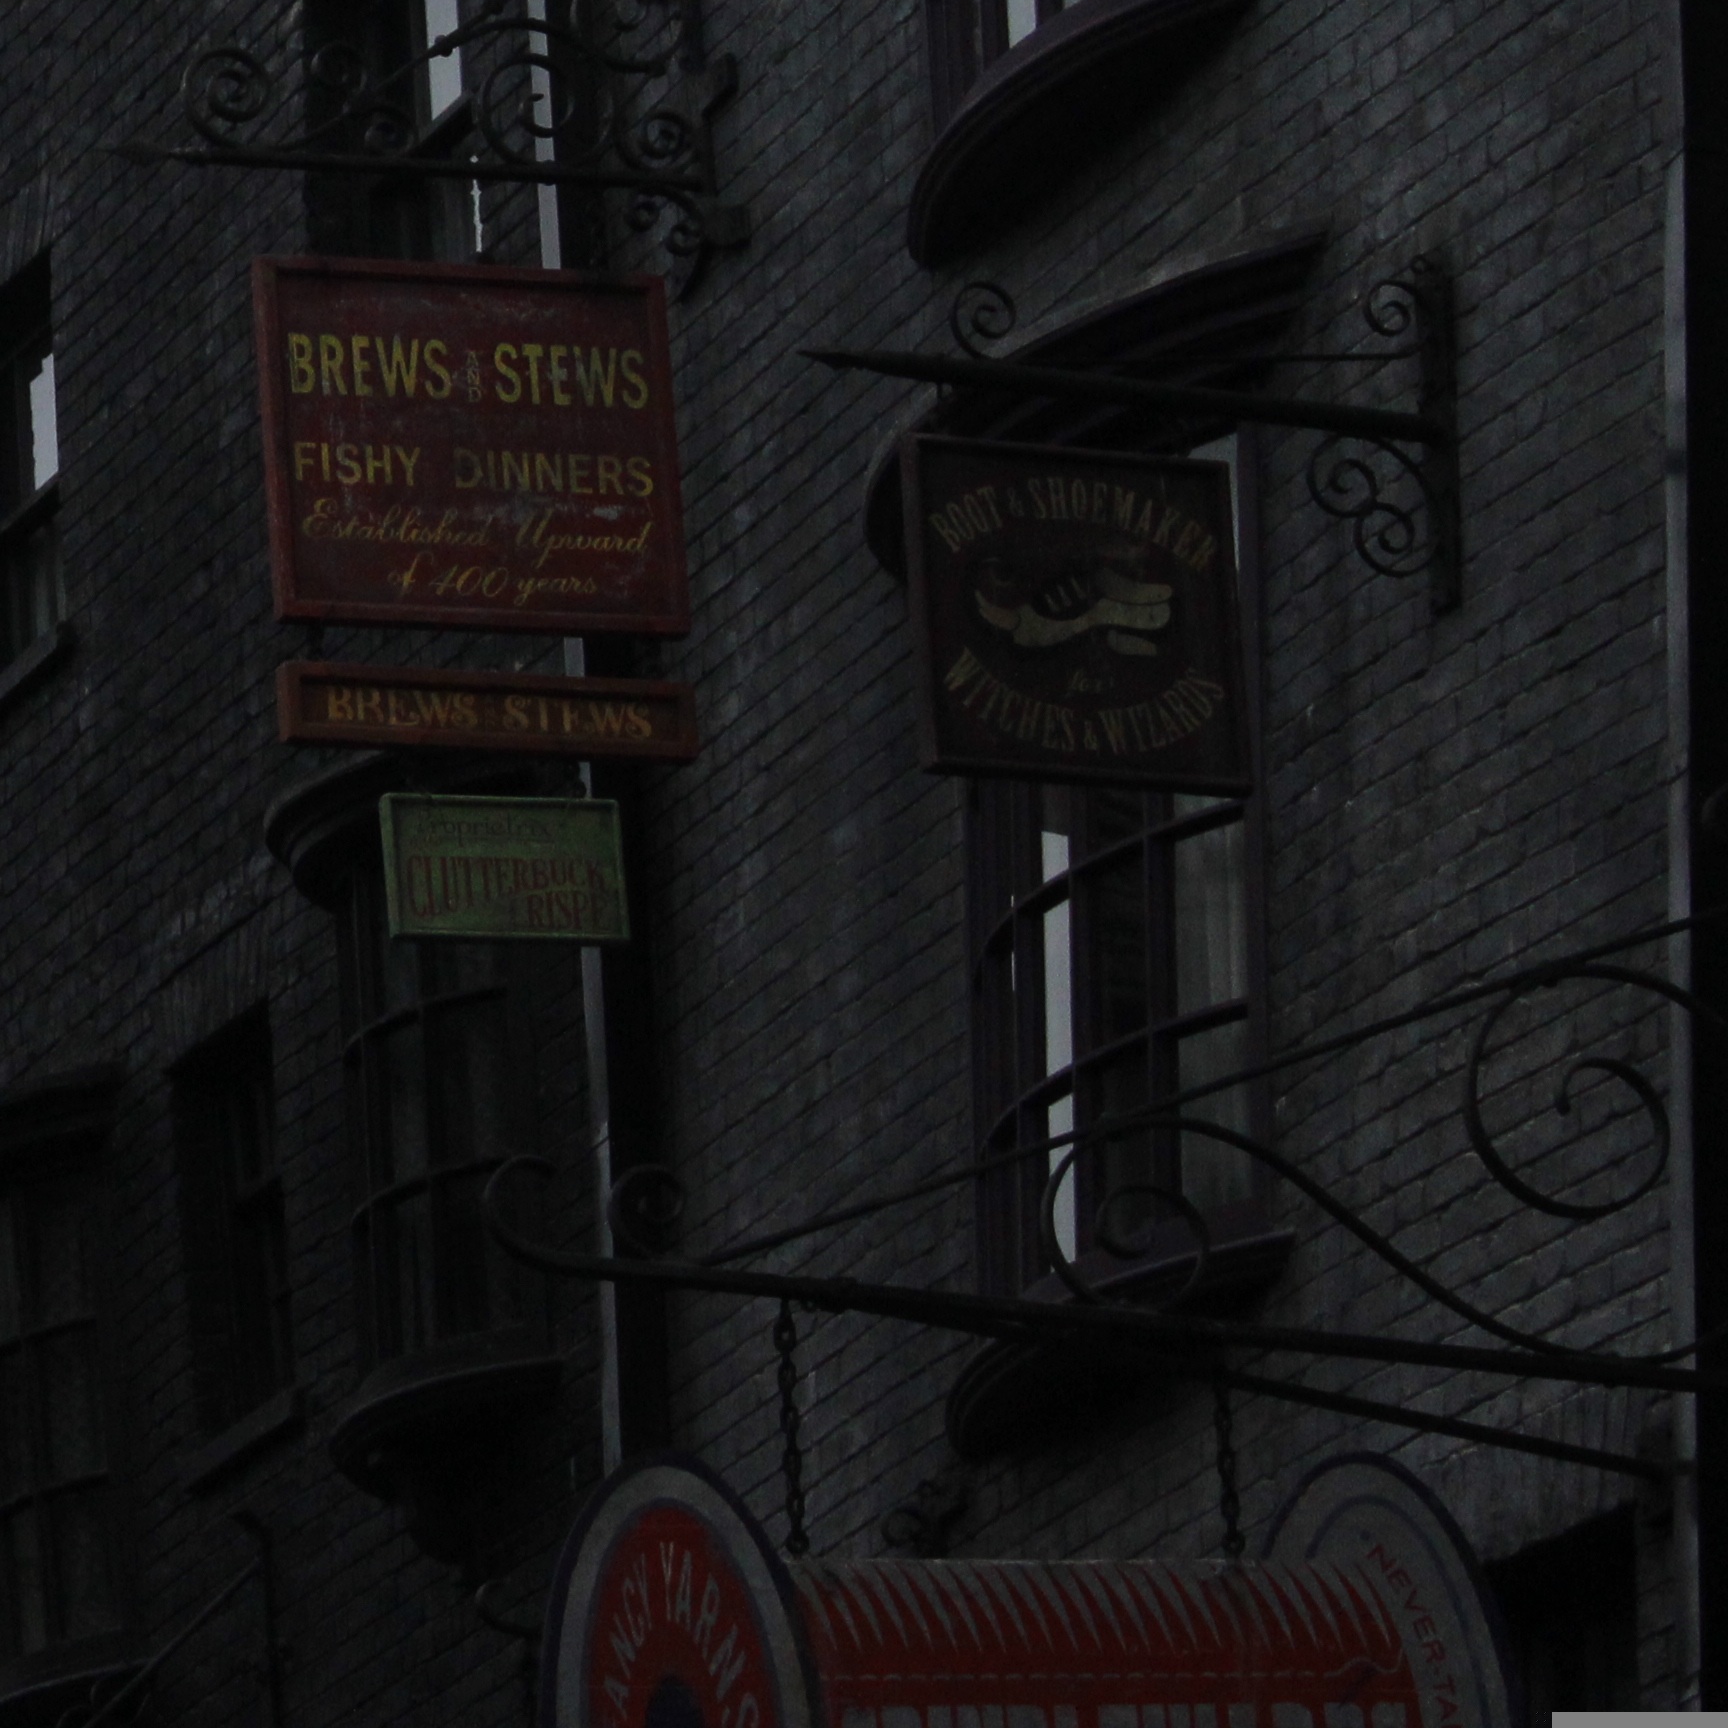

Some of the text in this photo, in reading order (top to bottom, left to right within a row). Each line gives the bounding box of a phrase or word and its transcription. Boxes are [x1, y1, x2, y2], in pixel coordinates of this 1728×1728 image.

[288, 332, 649, 410] BREWS AND STEWS
[293, 441, 654, 498] FISHY DINNERS
[302, 497, 653, 567] Established Upward
[929, 476, 1217, 571] BOOT & SHOEMAKER
[388, 551, 598, 606] of 400 years
[328, 685, 477, 727] BREWS
[501, 693, 652, 738] STEWS
[943, 645, 1226, 756] WITCHES & WIZARDS
[407, 856, 605, 916] CLUTTERBUCK
